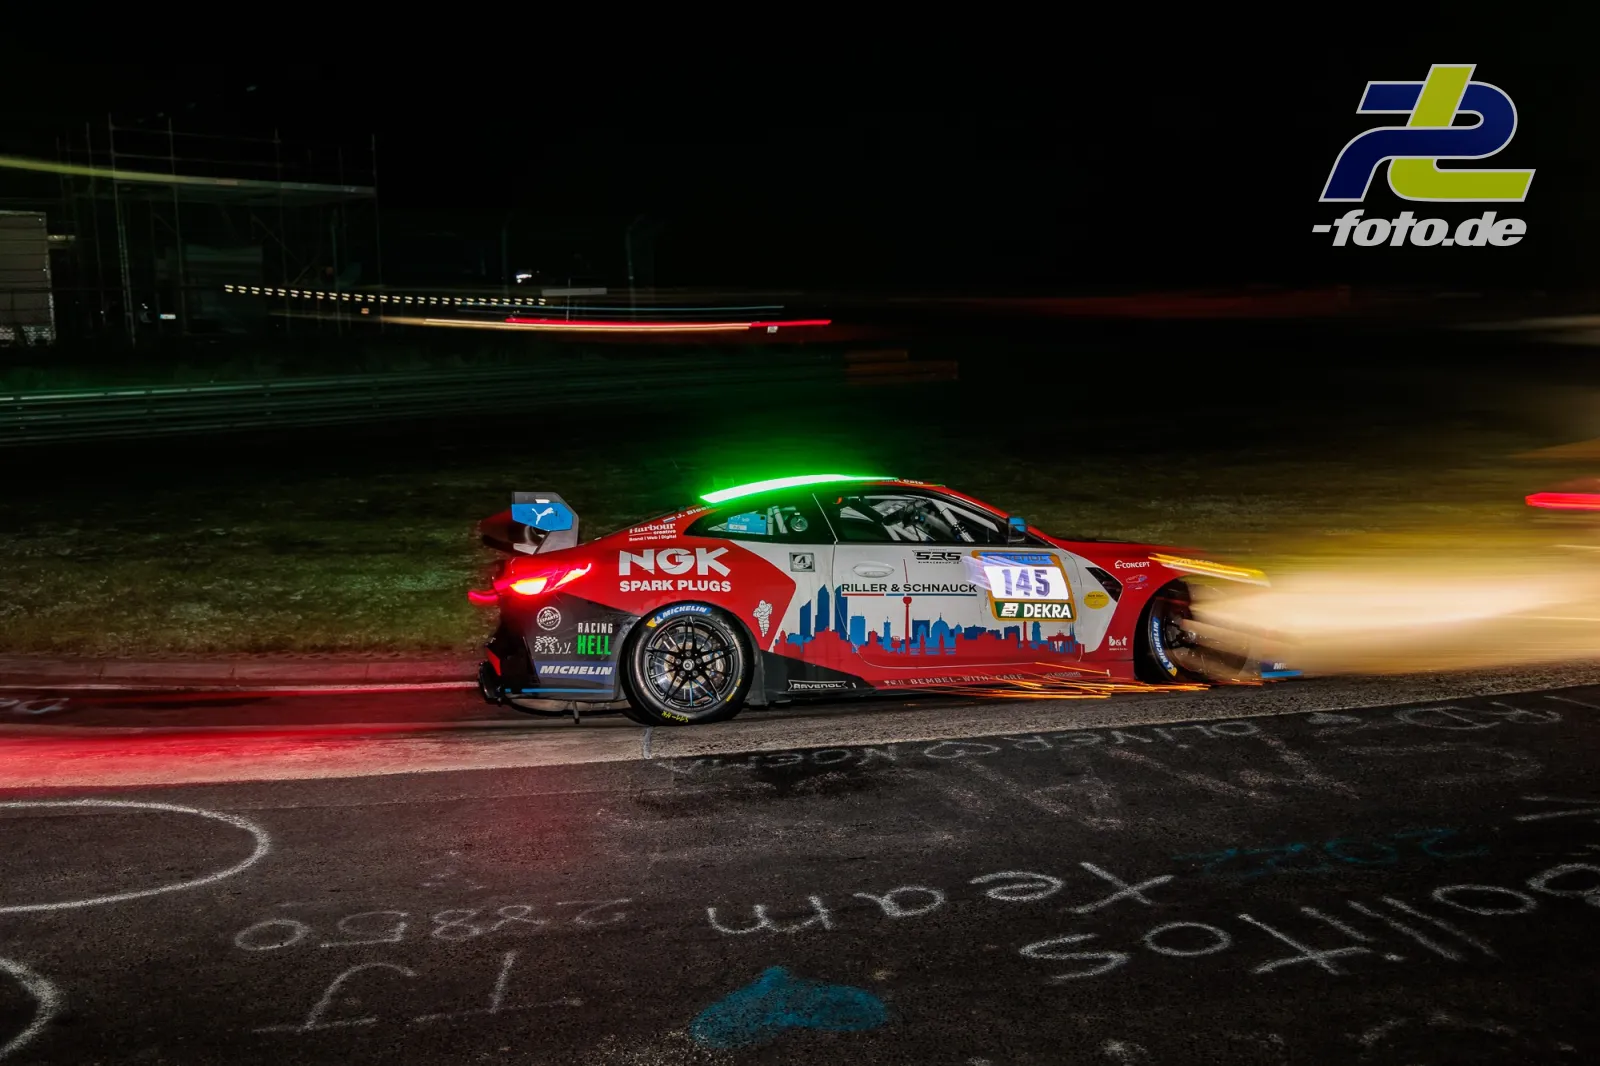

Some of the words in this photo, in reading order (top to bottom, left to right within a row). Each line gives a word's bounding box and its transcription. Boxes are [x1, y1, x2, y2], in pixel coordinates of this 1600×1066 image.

[618, 546, 731, 577] NGK
[619, 580, 674, 592] SPARK
[677, 580, 731, 592] PLUGS
[841, 584, 887, 592] RILLER
[891, 584, 900, 592] &
[903, 584, 977, 593] SCHNAUCK
[1002, 568, 1050, 597] 145
[662, 605, 707, 618] MICHELIN
[1023, 603, 1072, 618] DEKRA
[577, 622, 613, 634] RACING
[577, 634, 612, 655] HELL
[1153, 621, 1169, 664] MICHELIN
[540, 665, 613, 675] MICHELIN
